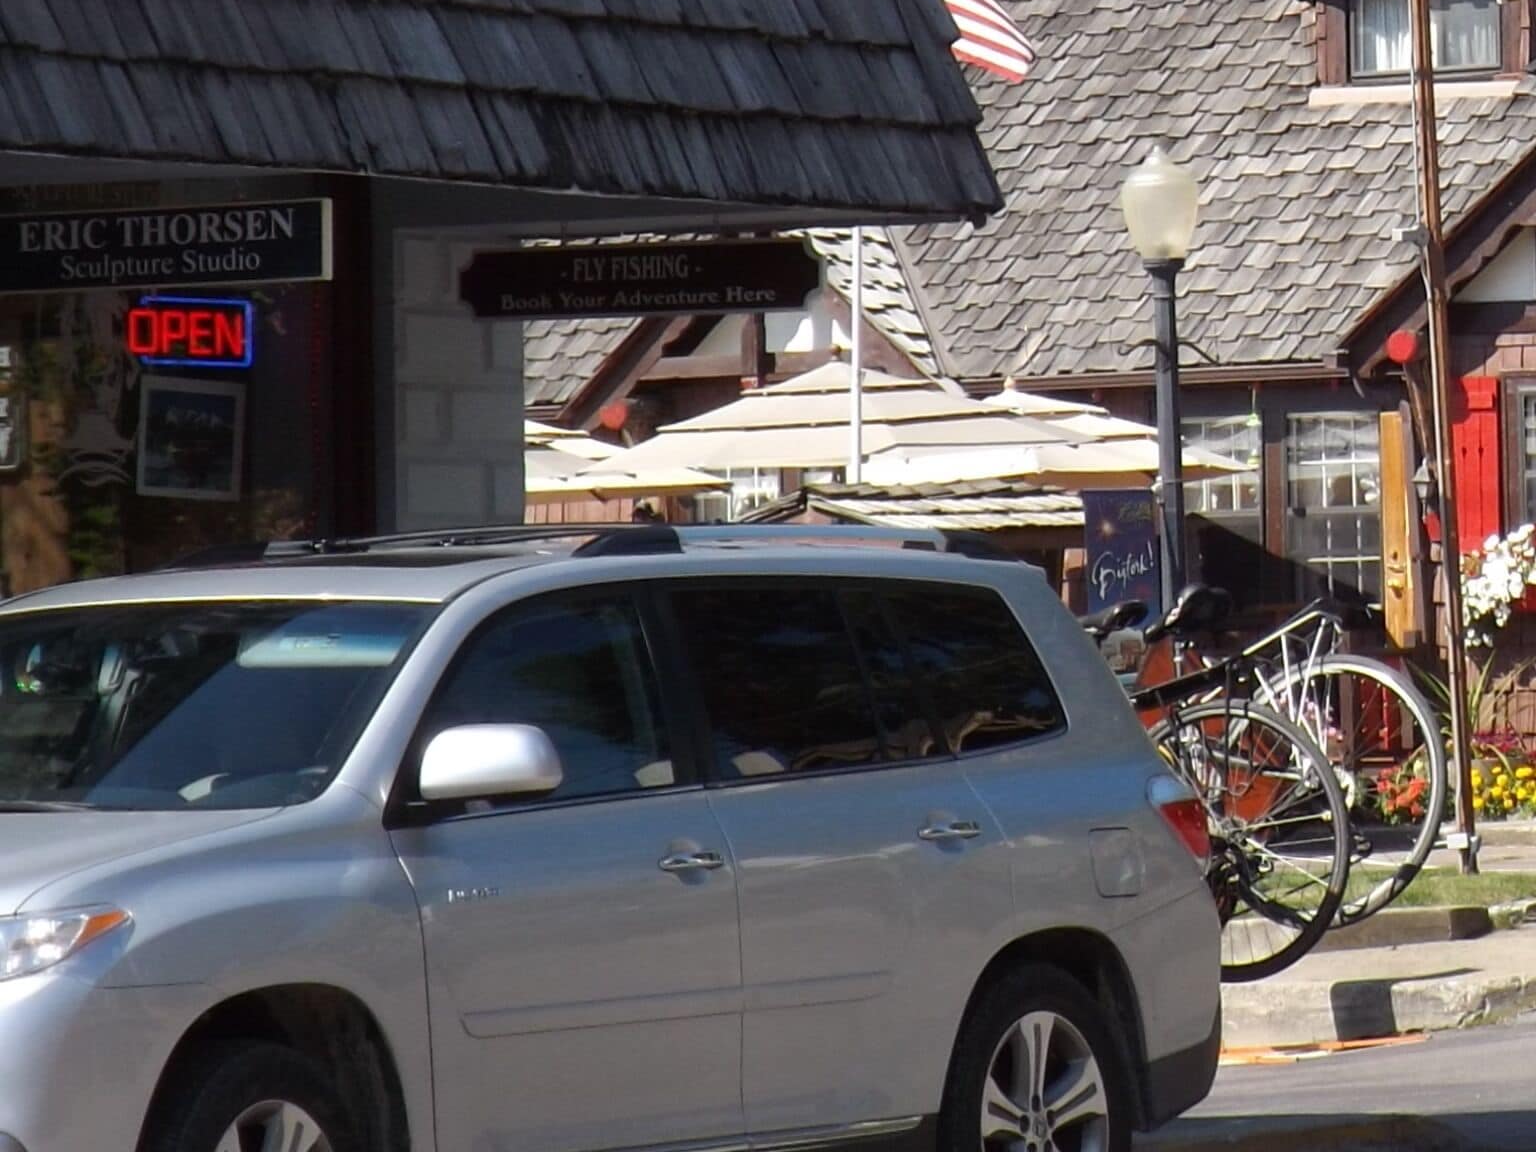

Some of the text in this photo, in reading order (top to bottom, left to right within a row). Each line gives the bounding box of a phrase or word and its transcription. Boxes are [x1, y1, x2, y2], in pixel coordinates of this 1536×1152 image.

[19, 207, 295, 253] ERIC THORSEN
[60, 247, 261, 283] Sculpture Studio
[572, 254, 689, 282] FLY FISHING
[501, 285, 777, 311] Book Your Adventure Here
[128, 307, 244, 357] OPEN
